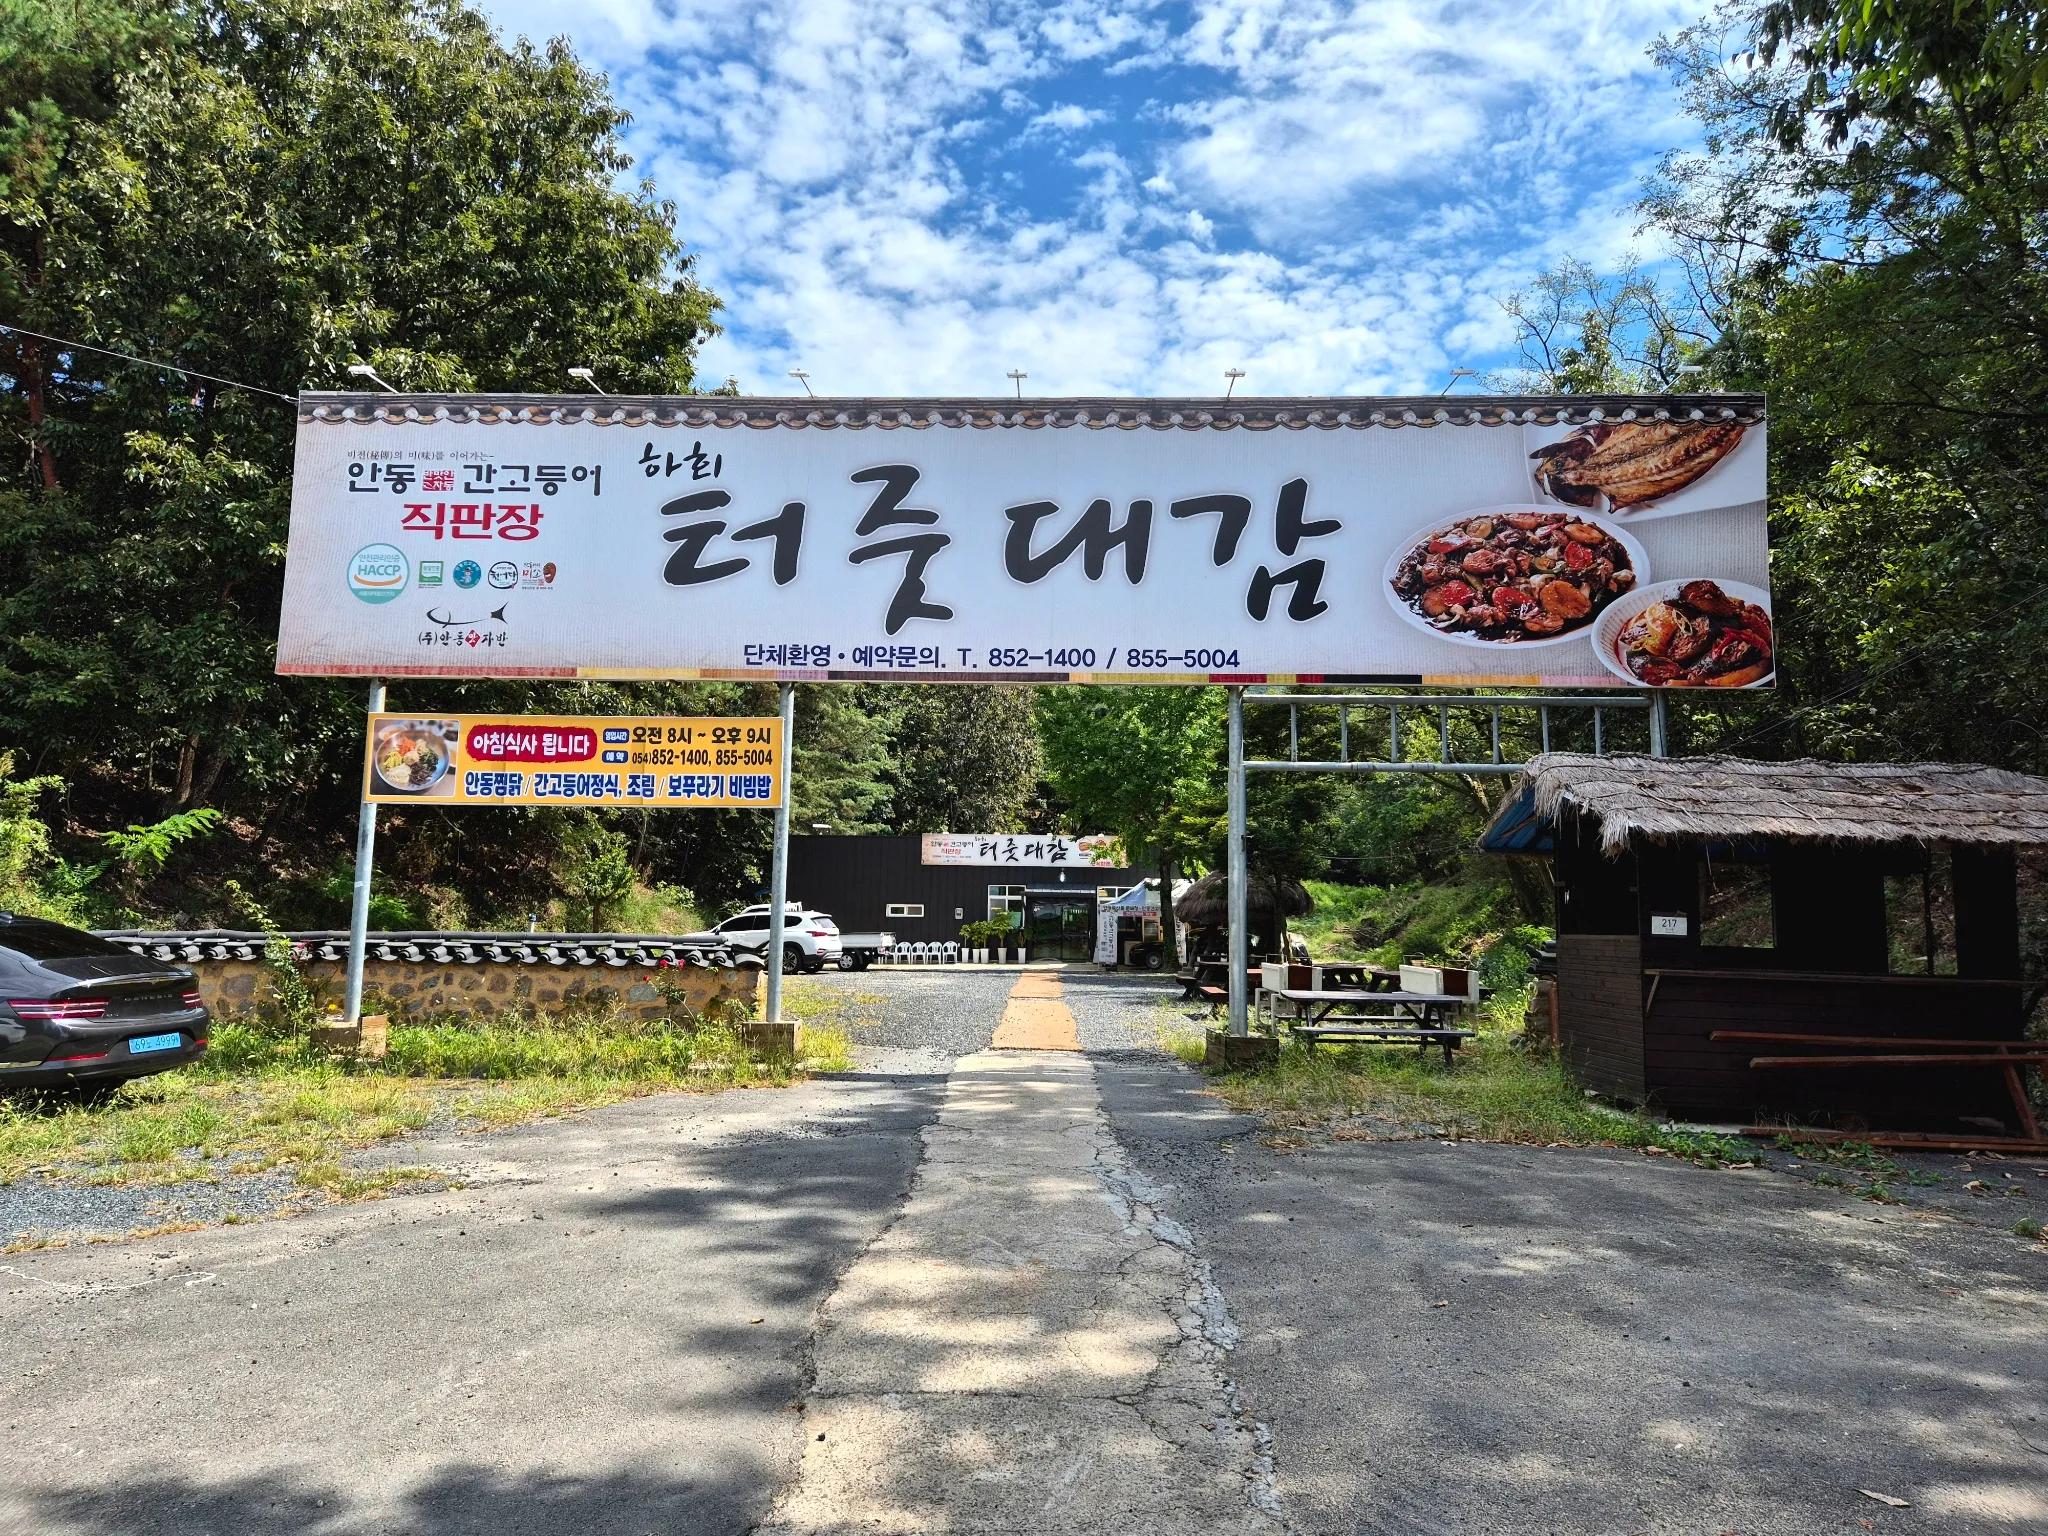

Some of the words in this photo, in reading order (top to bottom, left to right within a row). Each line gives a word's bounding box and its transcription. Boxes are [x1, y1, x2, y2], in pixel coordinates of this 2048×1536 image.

[638, 442, 722, 480] 하회
[348, 463, 416, 494] 안동
[463, 464, 602, 496] 간고등어
[401, 503, 544, 541] 직판장
[359, 554, 400, 562] 안전관리인증
[358, 565, 401, 576] HACCP
[988, 648, 1096, 667] 852-1400
[1127, 649, 1240, 668] 855-5004
[473, 732, 537, 756] 아침식사
[542, 733, 590, 756] 됩니다
[605, 731, 627, 741] 영업시간
[632, 727, 662, 744] 오전
[667, 728, 692, 744] 8시
[711, 727, 742, 745] 오후
[746, 728, 771, 745] 9시
[716, 750, 772, 765] 855-5004
[465, 772, 523, 796] 안동찜닭
[627, 774, 655, 798] 조림
[668, 775, 725, 798] 보푸라기
[729, 775, 771, 799] 비빔밥
[1662, 918, 1677, 928] 217
[156, 1035, 175, 1046] 4999
